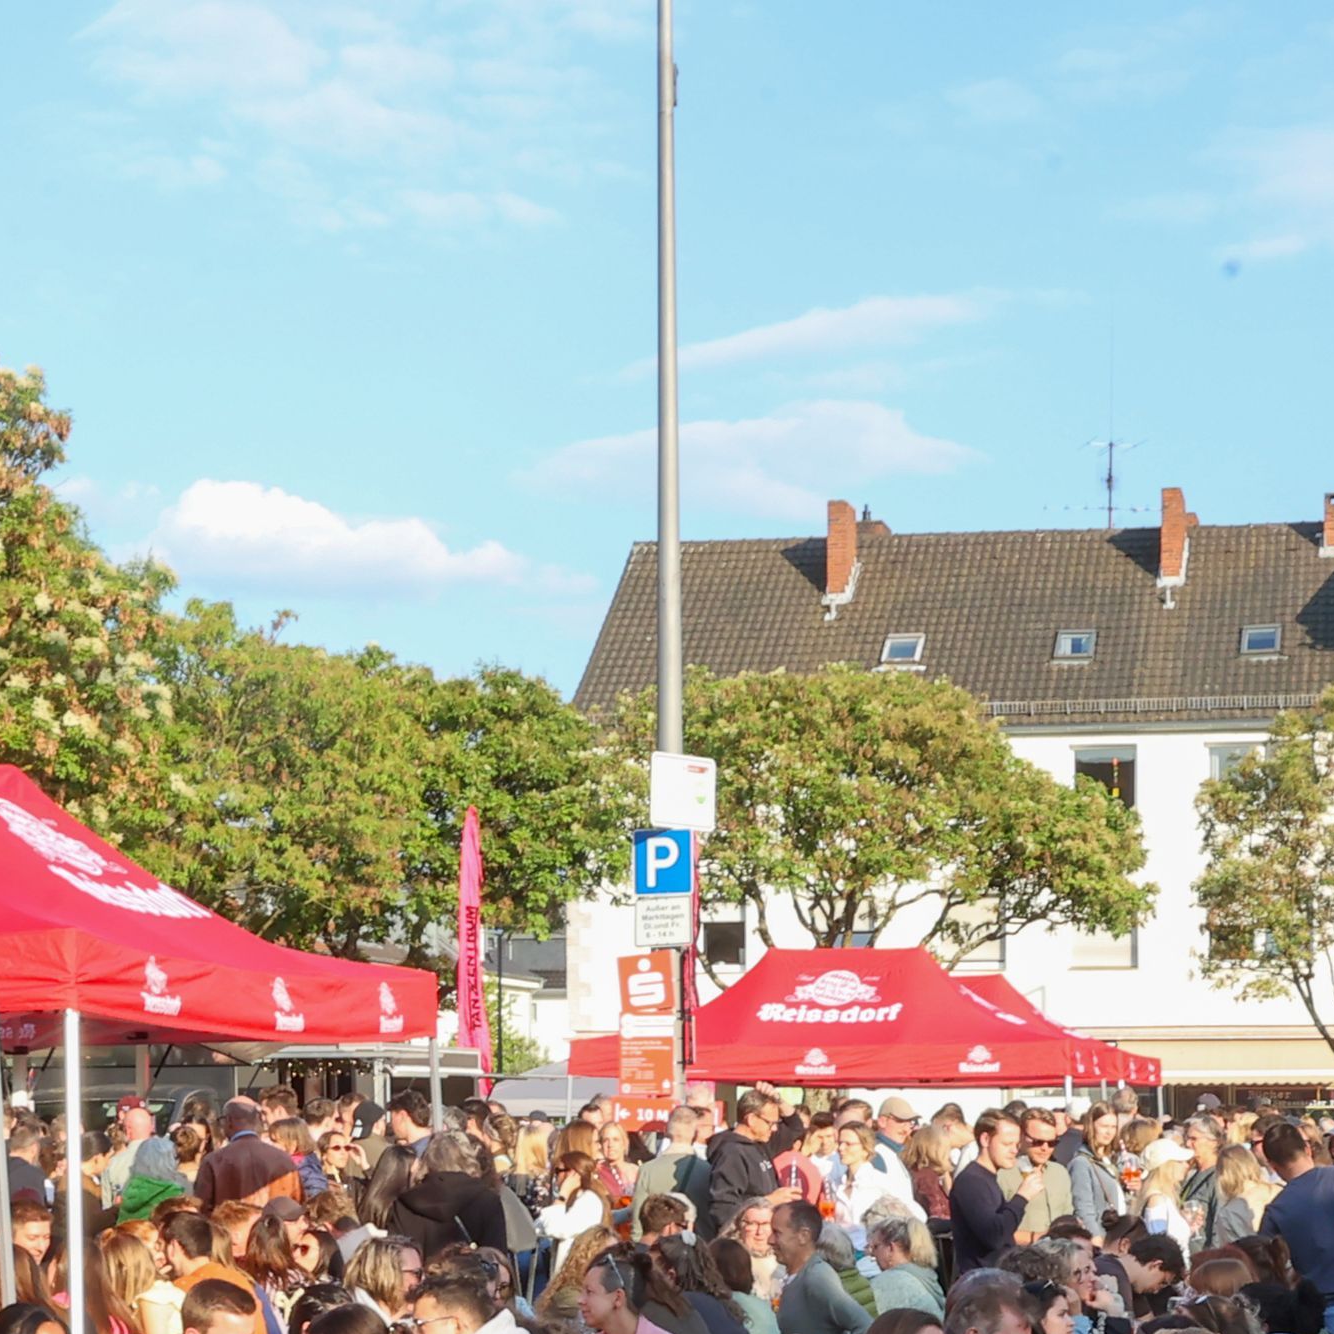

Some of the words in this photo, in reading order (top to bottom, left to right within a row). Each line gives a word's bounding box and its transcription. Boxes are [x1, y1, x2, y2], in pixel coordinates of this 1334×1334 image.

[646, 836, 679, 888] P
[756, 1002, 903, 1024] Reissdorf
[636, 1108, 654, 1121] 10
